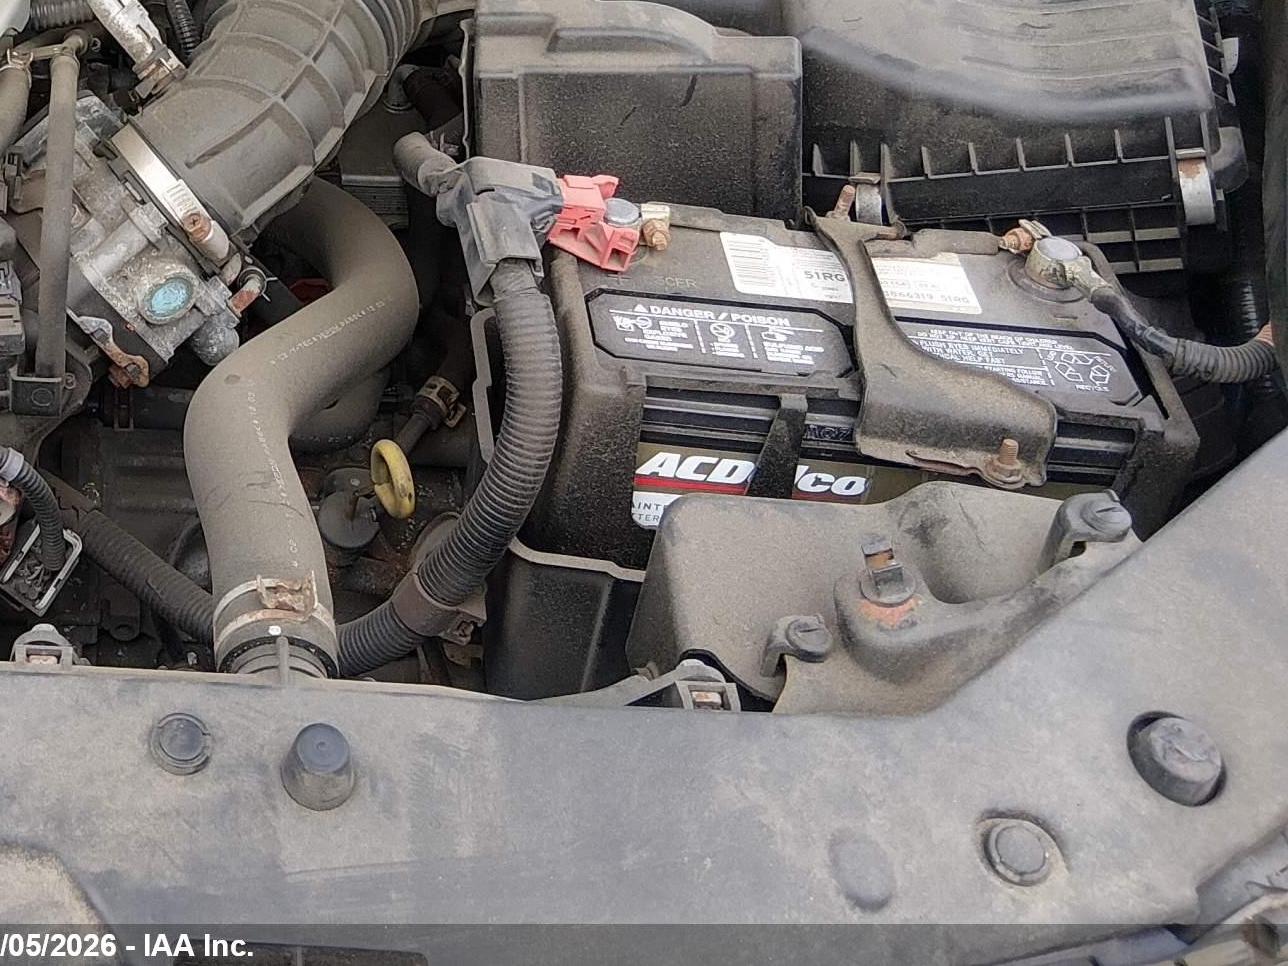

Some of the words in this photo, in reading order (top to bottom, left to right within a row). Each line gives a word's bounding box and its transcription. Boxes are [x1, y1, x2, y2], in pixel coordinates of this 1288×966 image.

[804, 270, 846, 283] 51RG
[650, 304, 716, 320] DANGER
[731, 313, 790, 327] POISON
[970, 344, 1024, 355] IMMEDIATELY
[636, 452, 867, 495] ACDlco
